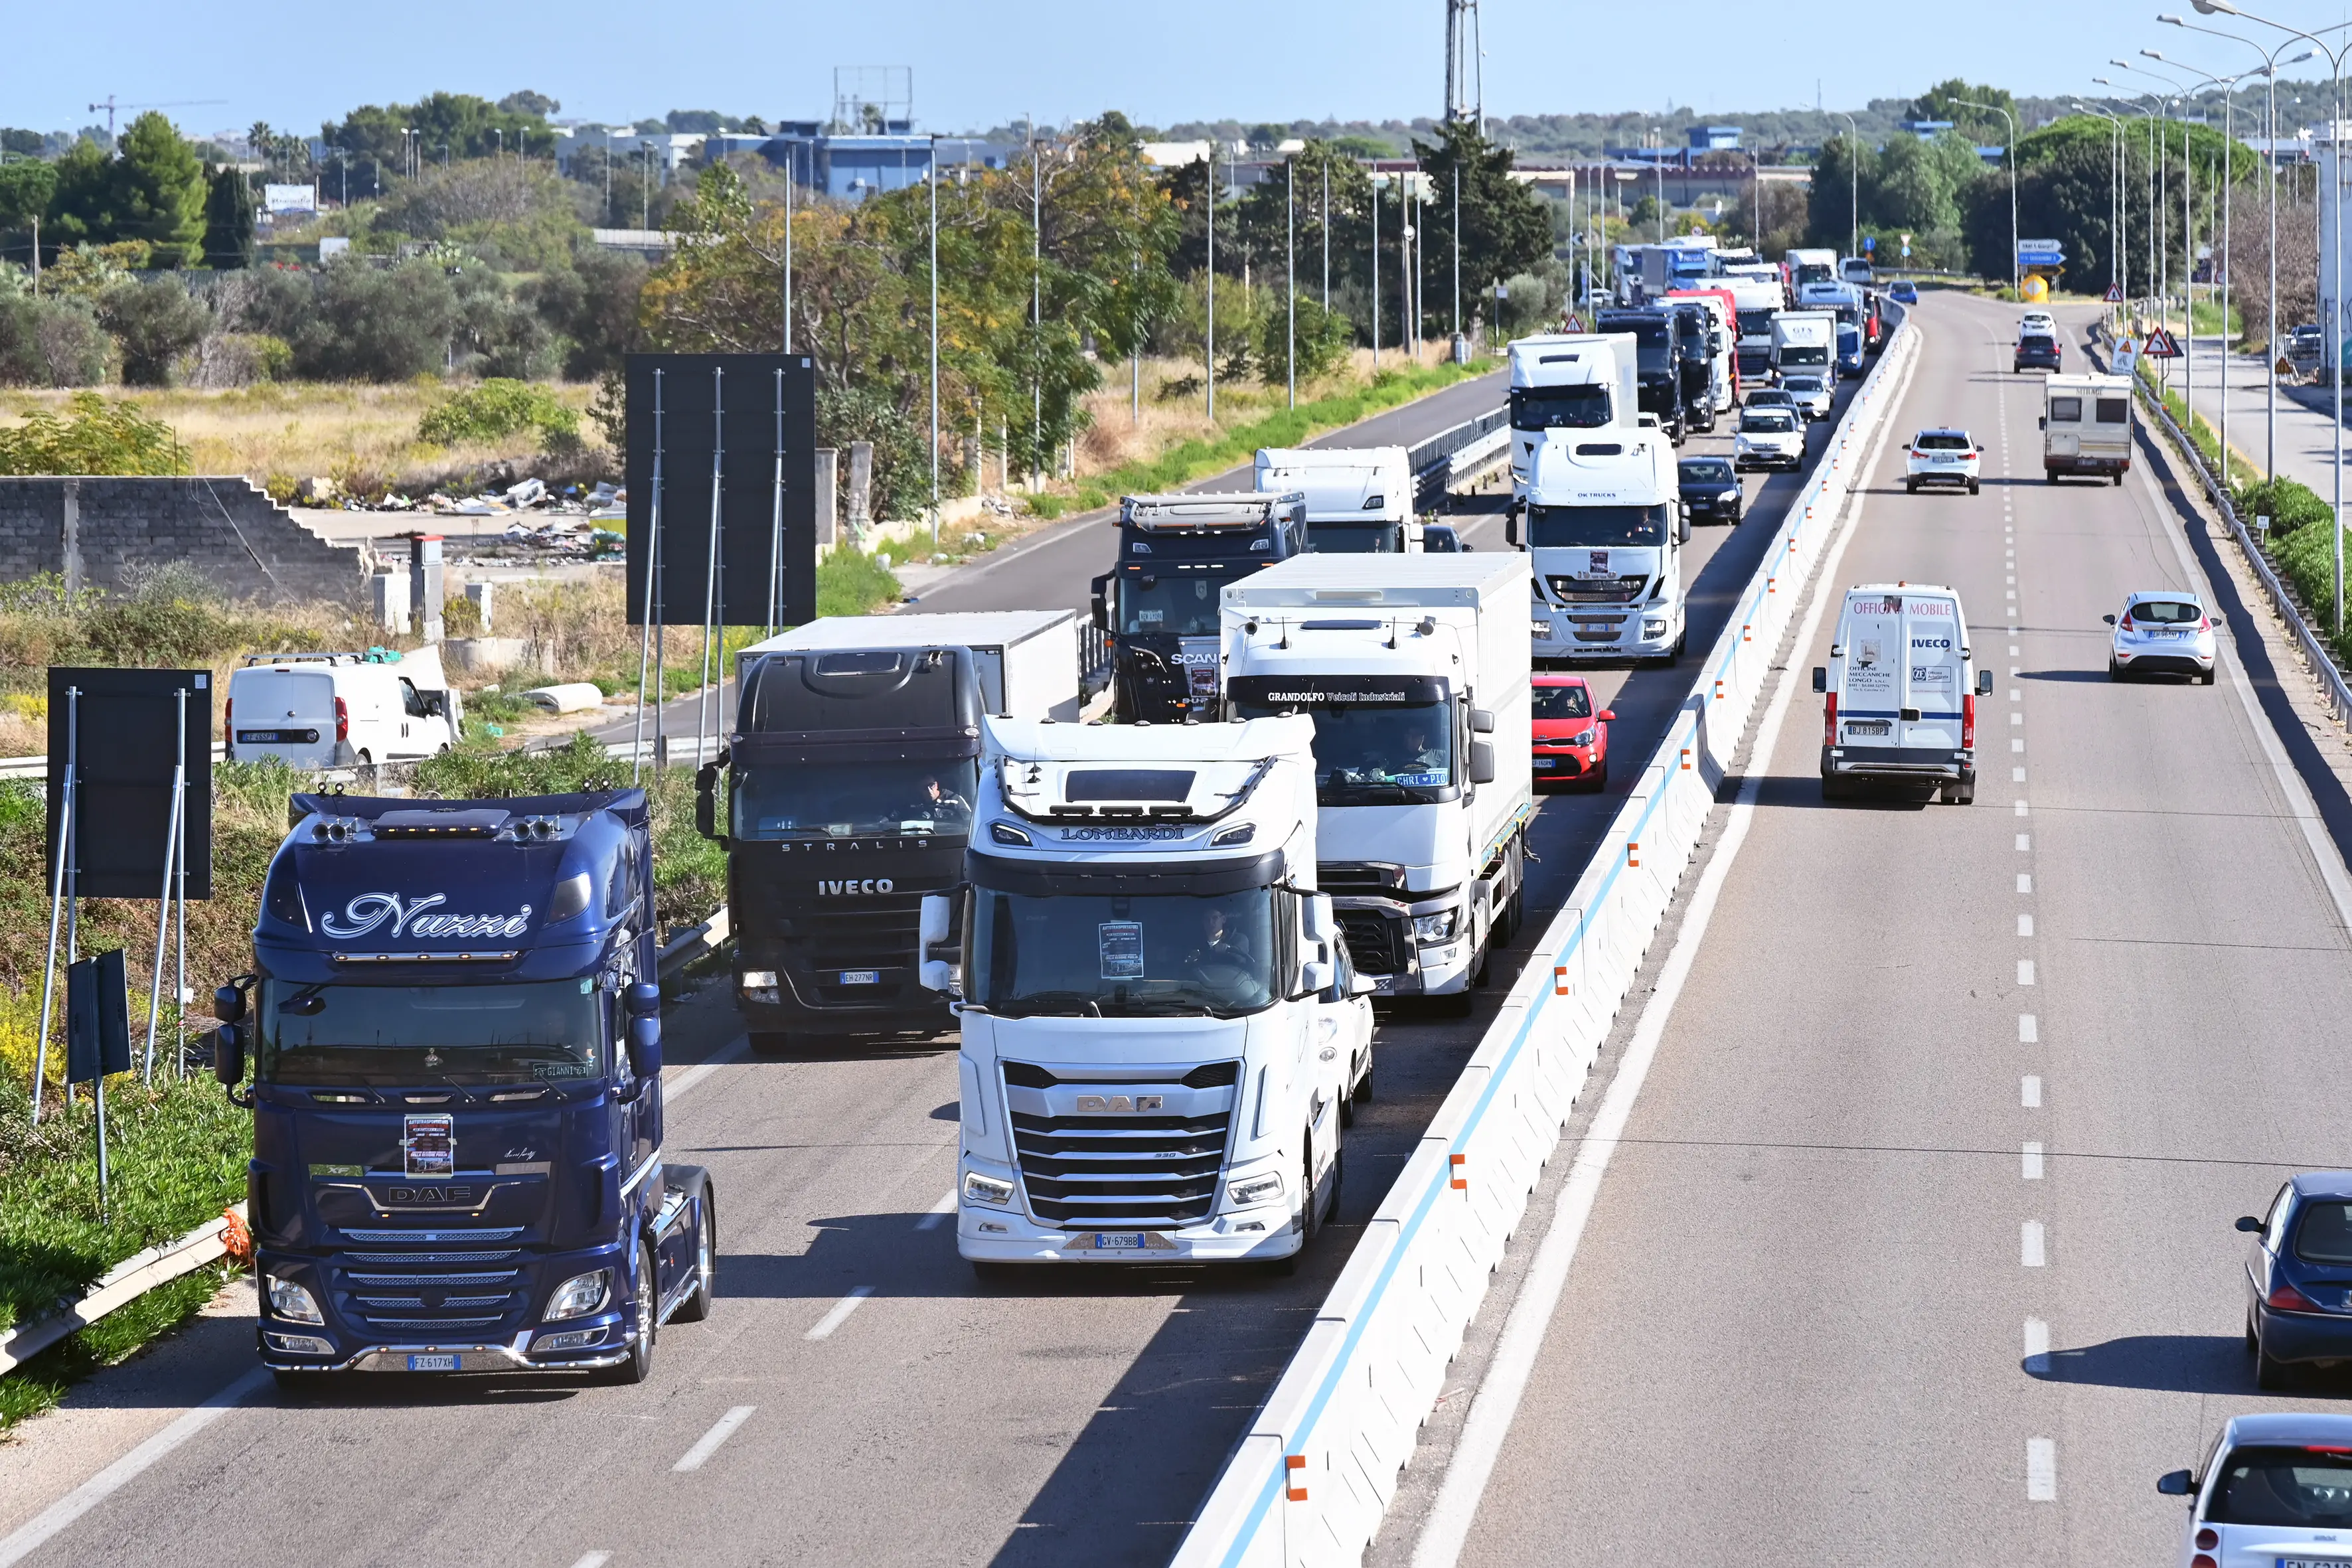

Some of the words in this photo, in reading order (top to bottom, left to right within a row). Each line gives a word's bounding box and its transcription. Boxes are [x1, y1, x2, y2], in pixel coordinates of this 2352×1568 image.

[1909, 603, 1951, 615] MOBILE
[1911, 639, 1950, 648] IVECO
[1268, 692, 1324, 702] GRANDOLFO
[1326, 692, 1357, 701] Veicoli
[1358, 692, 1405, 701] Industriali
[1863, 726, 1884, 735] 815BP
[1397, 775, 1419, 785] CHRI
[1430, 774, 1445, 784] PIO
[1061, 827, 1184, 840] LOMBARDI
[782, 840, 927, 852] STRALIS
[819, 878, 894, 896] IVECO
[321, 892, 532, 939] Nuzzi
[547, 1066, 574, 1076] GIANNI
[1077, 1095, 1163, 1112] DAF
[388, 1186, 471, 1202] DAF
